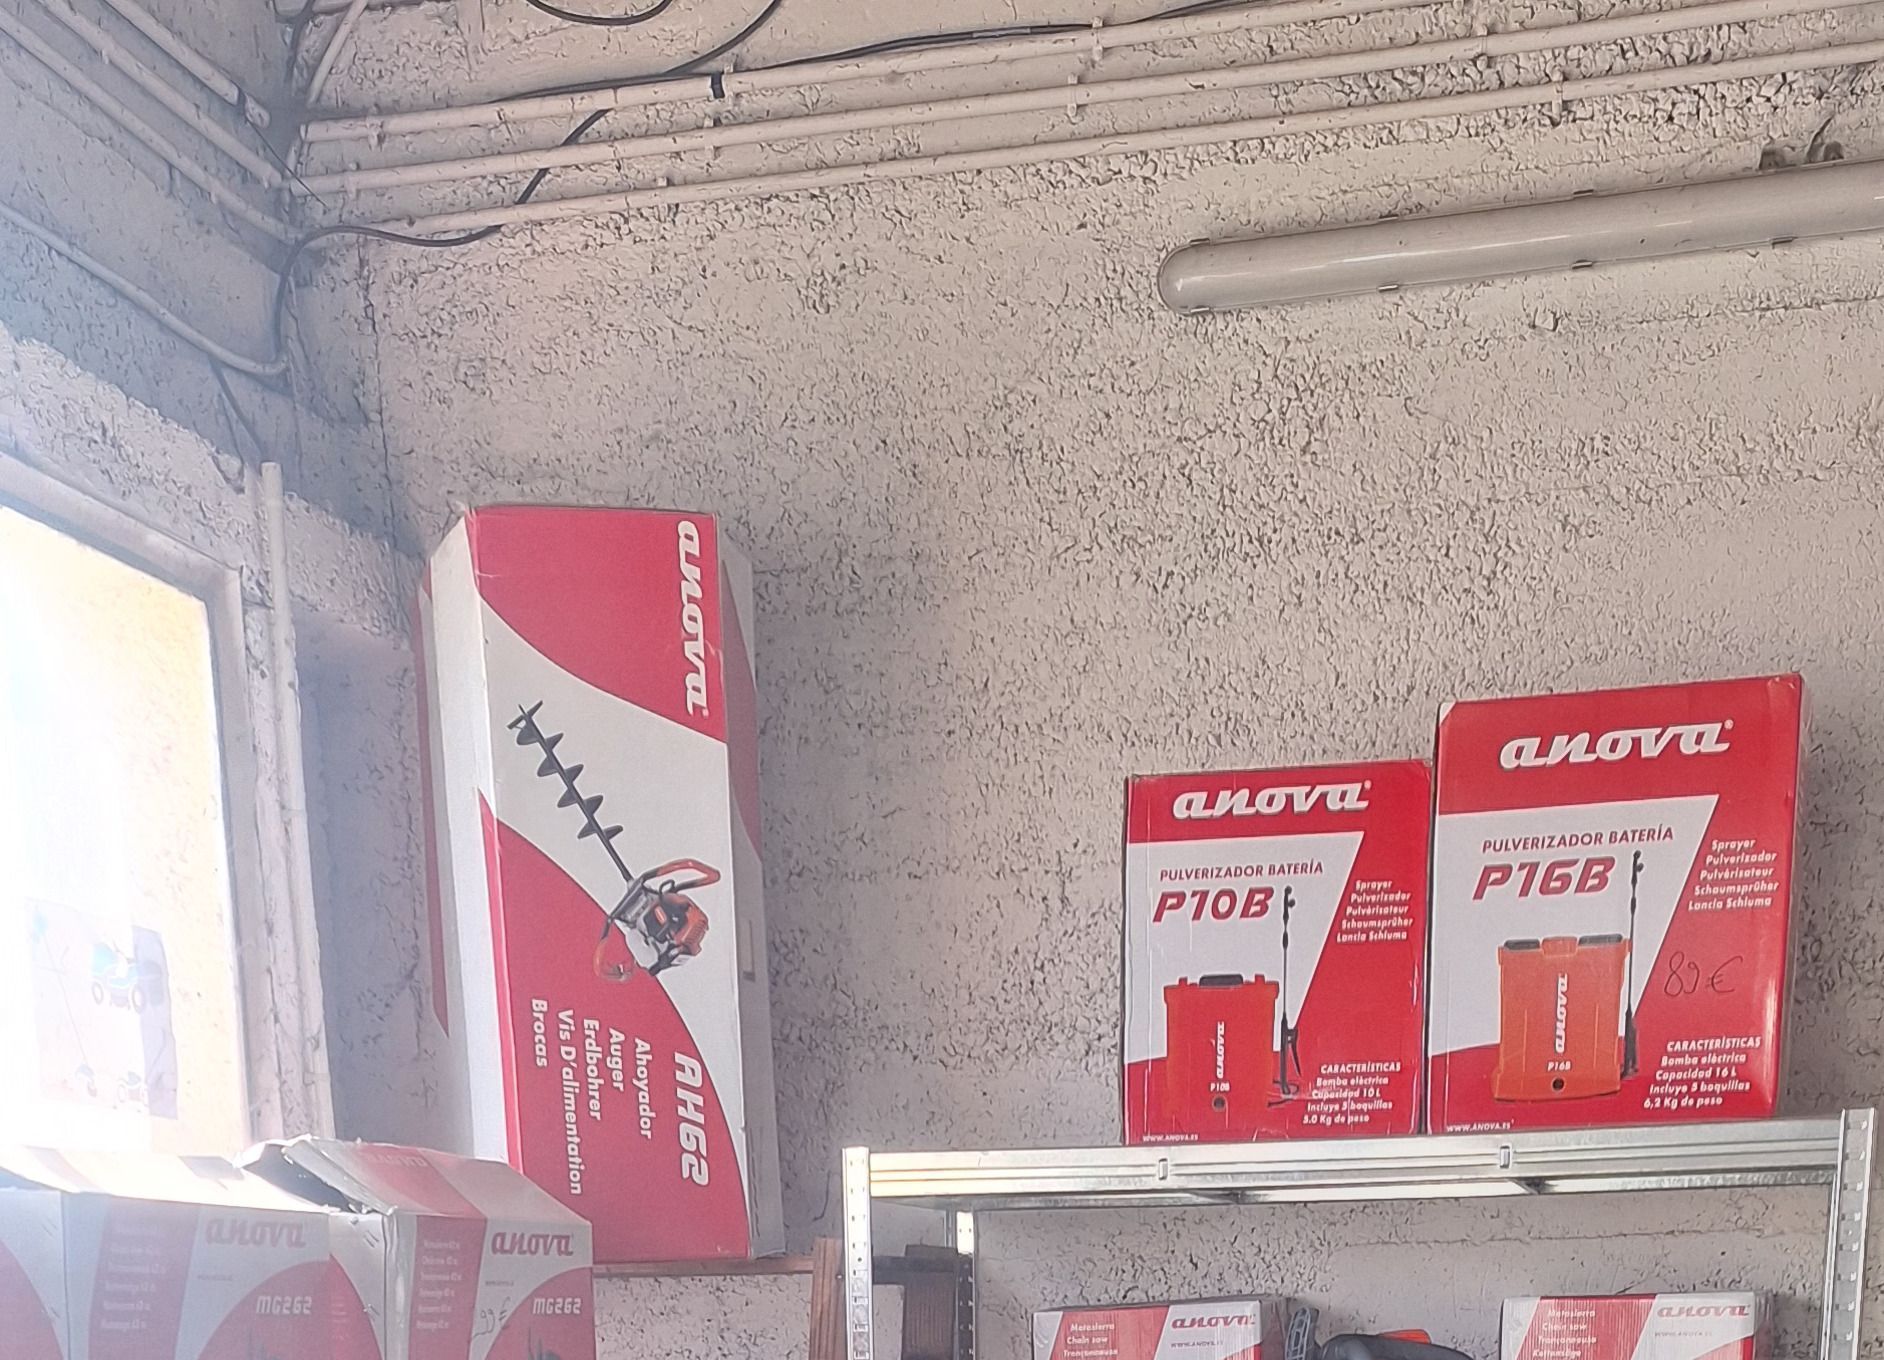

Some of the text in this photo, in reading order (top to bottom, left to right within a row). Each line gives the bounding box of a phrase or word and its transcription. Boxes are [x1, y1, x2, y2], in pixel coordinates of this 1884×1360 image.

[678, 521, 708, 716] anova
[1499, 721, 1733, 769] anova
[1172, 783, 1370, 820] anova
[1482, 824, 1674, 853] PULVERIZADOR BATERÍA
[1711, 839, 1756, 853] Sprayer
[1706, 849, 1777, 866] Pulverizador
[1160, 858, 1324, 882] PULVERIZADOR BATERÍA
[1472, 856, 1616, 901] P16B
[1355, 880, 1393, 892] Sprayer
[1152, 886, 1274, 923] P10B
[1350, 890, 1411, 903] Pulverizador
[531, 998, 548, 1068] Brocas
[558, 1009, 575, 1041] Vis
[1666, 1036, 1761, 1052] CARACTERÍSTICAS
[606, 1027, 625, 1091] Auger
[1320, 1061, 1401, 1074] CARACTERÍSTICAS
[1547, 1061, 1571, 1071] P16B
[1661, 1054, 1698, 1067] Bomba
[583, 1018, 604, 1120] Erdbohrer
[1655, 1066, 1737, 1082] Capacidad 16 L
[633, 1038, 656, 1139] Ahoyador
[1210, 1082, 1230, 1092] P10B
[1316, 1076, 1348, 1087] Bomba
[1649, 1083, 1688, 1095] Incluye
[1700, 1080, 1751, 1094] boquillas
[1311, 1088, 1360, 1101] Capacidad
[1363, 1087, 1375, 1098] 10
[1307, 1101, 1340, 1113] Incluye
[1350, 1099, 1393, 1112] boquillas
[1663, 1097, 1678, 1110] Kg
[1680, 1096, 1694, 1107] de
[1696, 1096, 1723, 1109] peso
[675, 1052, 709, 1186] AH62
[1320, 1114, 1332, 1126] Kg
[1334, 1114, 1345, 1123] de
[1347, 1115, 1370, 1125] peso
[491, 1231, 574, 1256] anova
[256, 1295, 313, 1316] MG262
[532, 1297, 583, 1315] MG262
